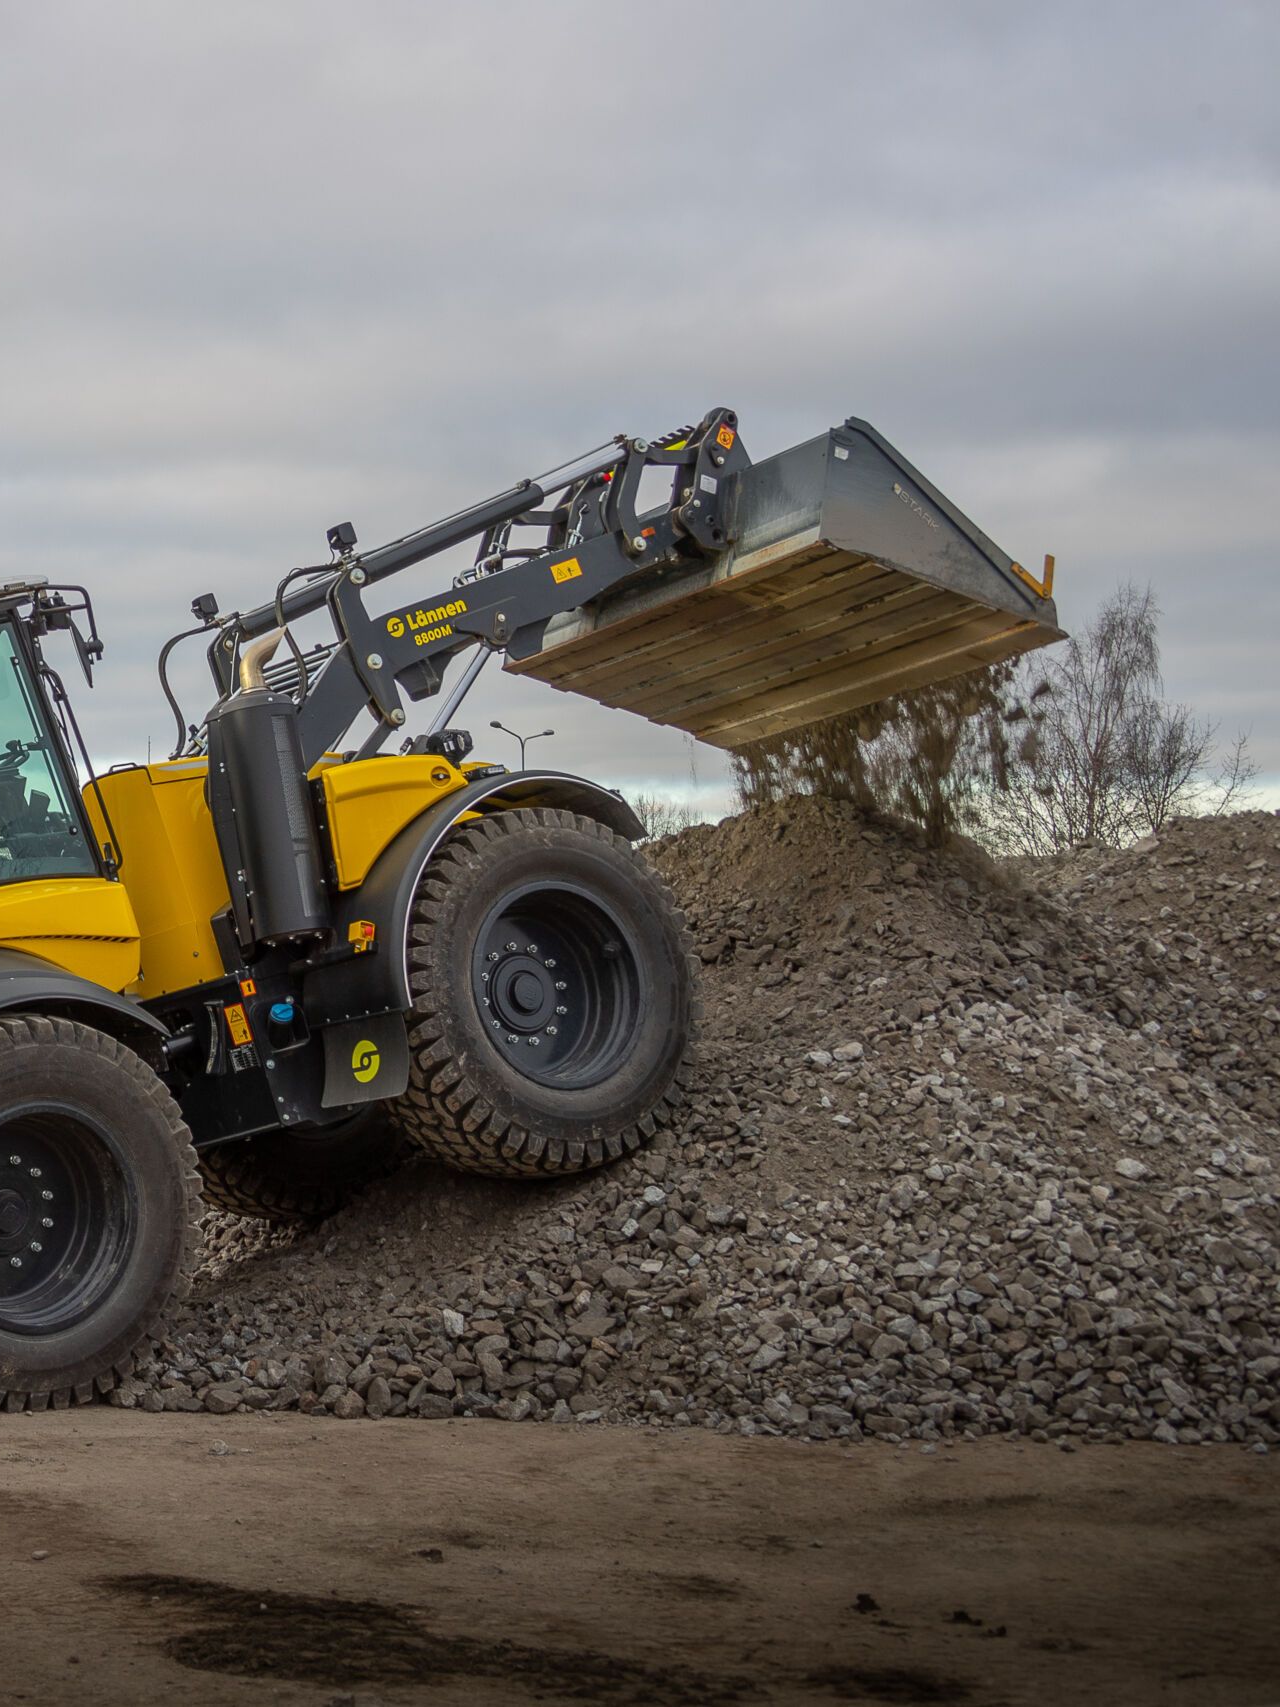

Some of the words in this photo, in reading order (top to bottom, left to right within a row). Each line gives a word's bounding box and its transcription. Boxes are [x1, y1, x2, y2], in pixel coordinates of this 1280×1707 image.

[899, 490, 939, 531] STARK
[405, 599, 468, 631] Lännen
[414, 623, 453, 646] 8800M
